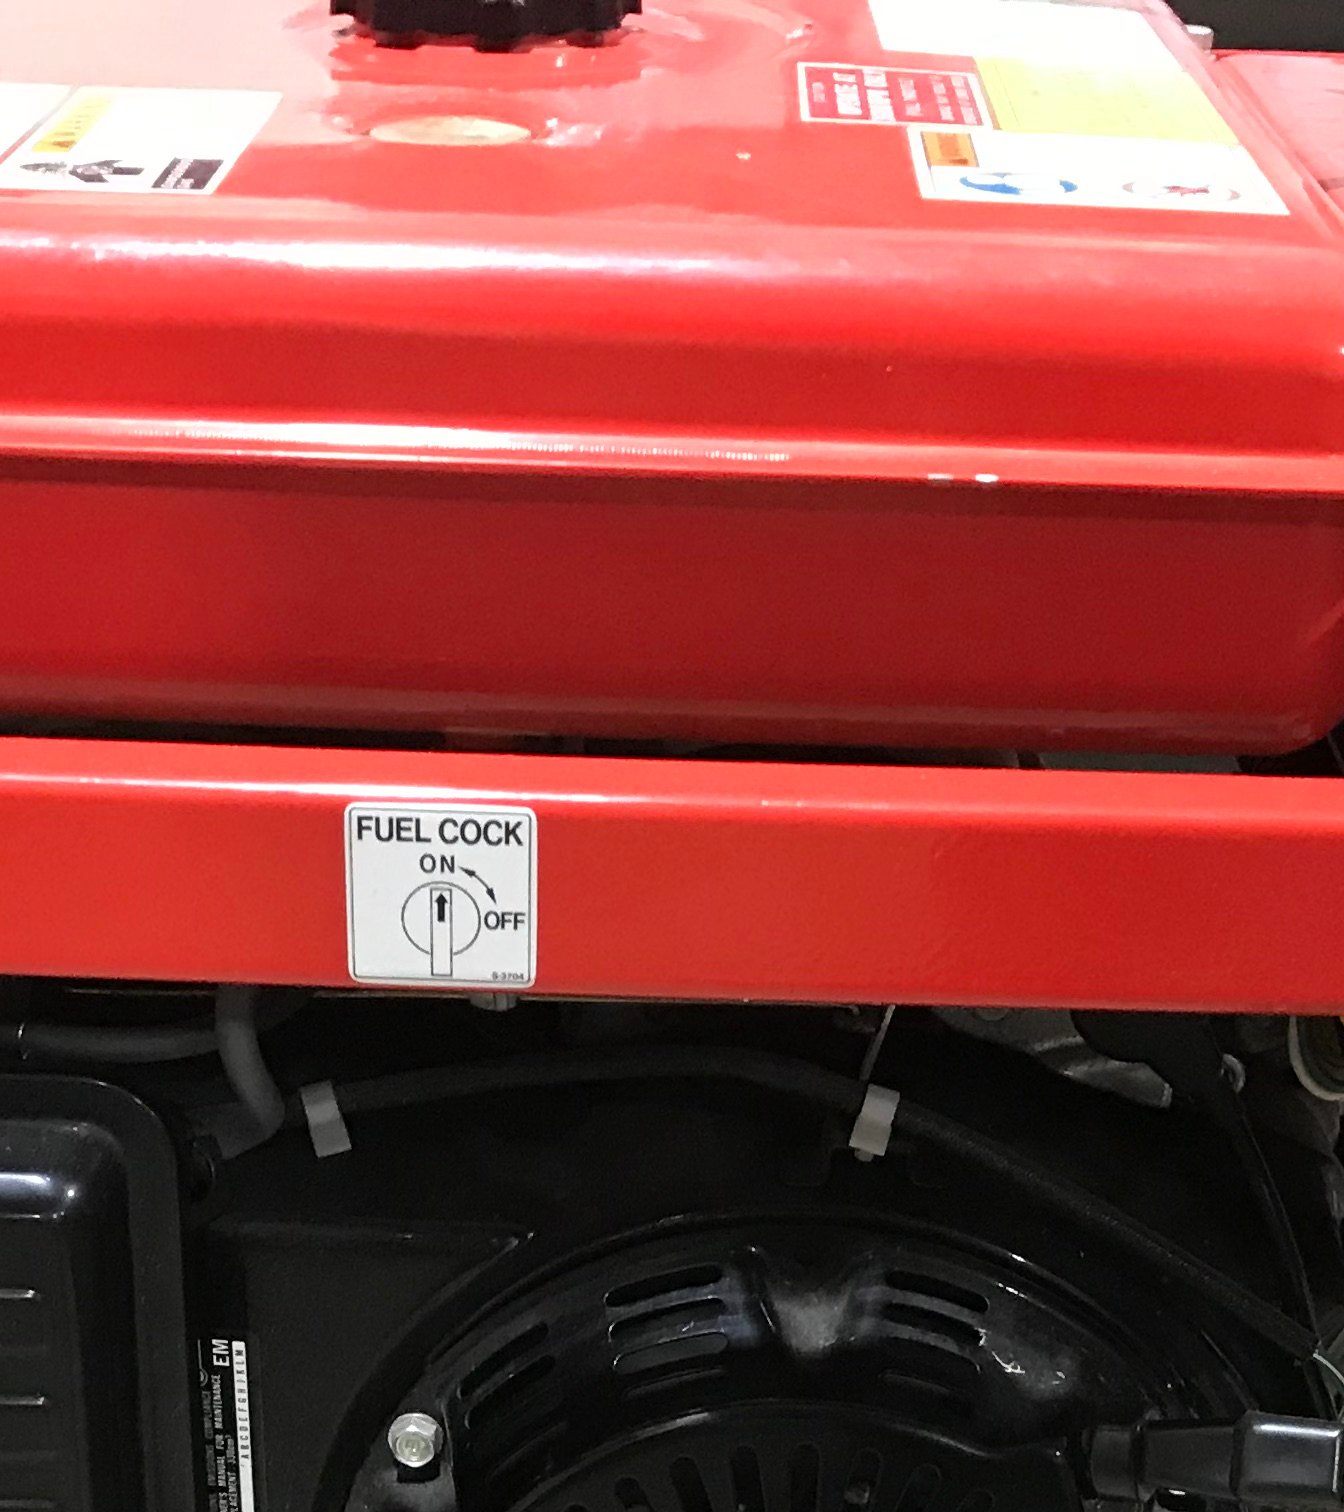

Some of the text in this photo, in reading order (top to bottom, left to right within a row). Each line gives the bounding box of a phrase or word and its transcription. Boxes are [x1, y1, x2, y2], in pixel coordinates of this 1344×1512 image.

[356, 815, 524, 847] FUEL COCK
[419, 852, 456, 874] ON
[483, 910, 526, 931] OFF
[211, 1338, 231, 1367] EM
